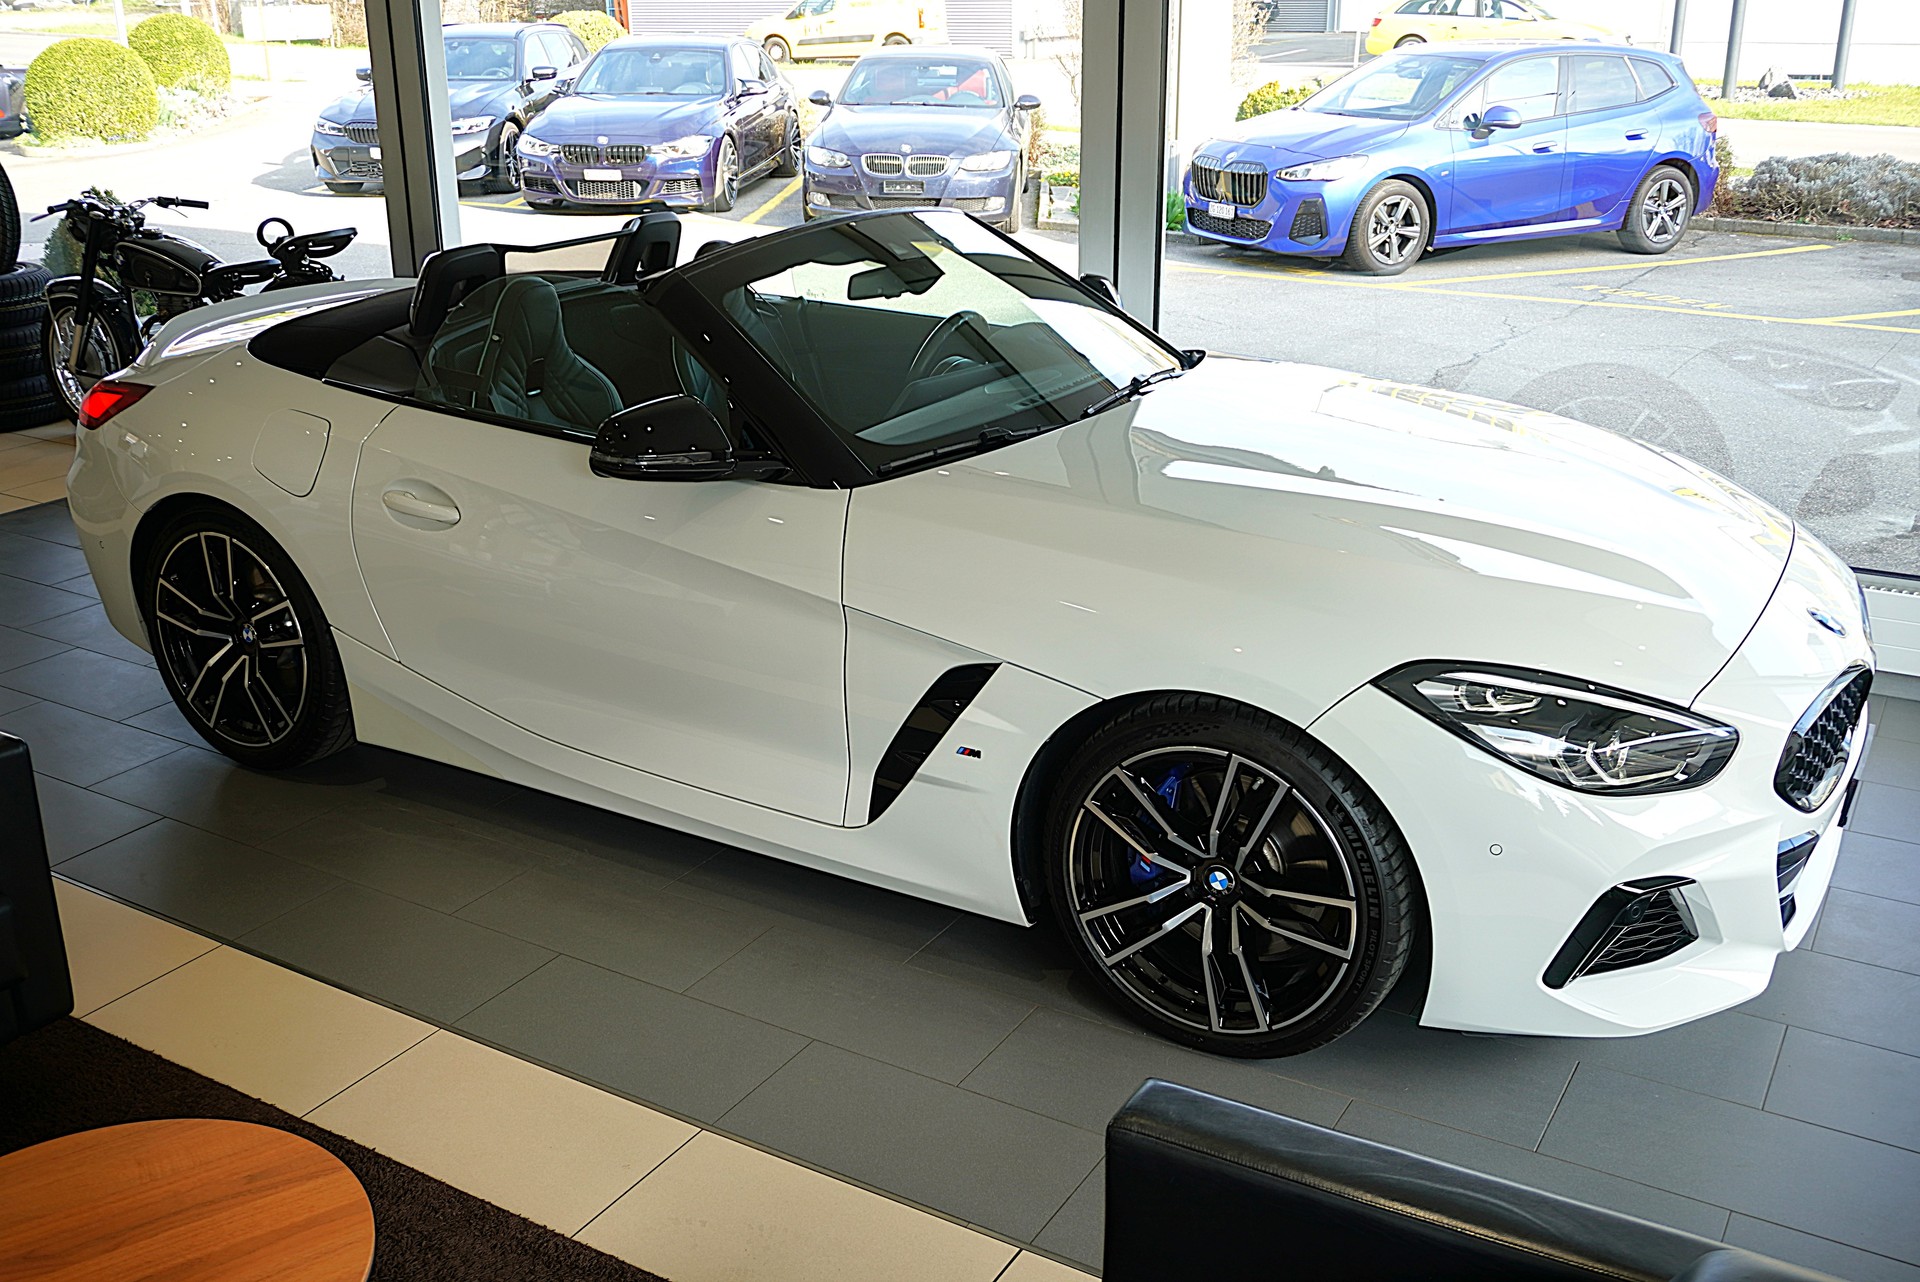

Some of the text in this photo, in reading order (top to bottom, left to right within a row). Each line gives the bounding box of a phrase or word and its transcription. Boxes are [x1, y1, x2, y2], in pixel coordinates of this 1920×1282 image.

[1571, 285, 1733, 309] KUNDEN
[1342, 825, 1380, 919] MICHELIN
[1367, 929, 1378, 957] PILOT
[1355, 959, 1372, 989] SPORT
